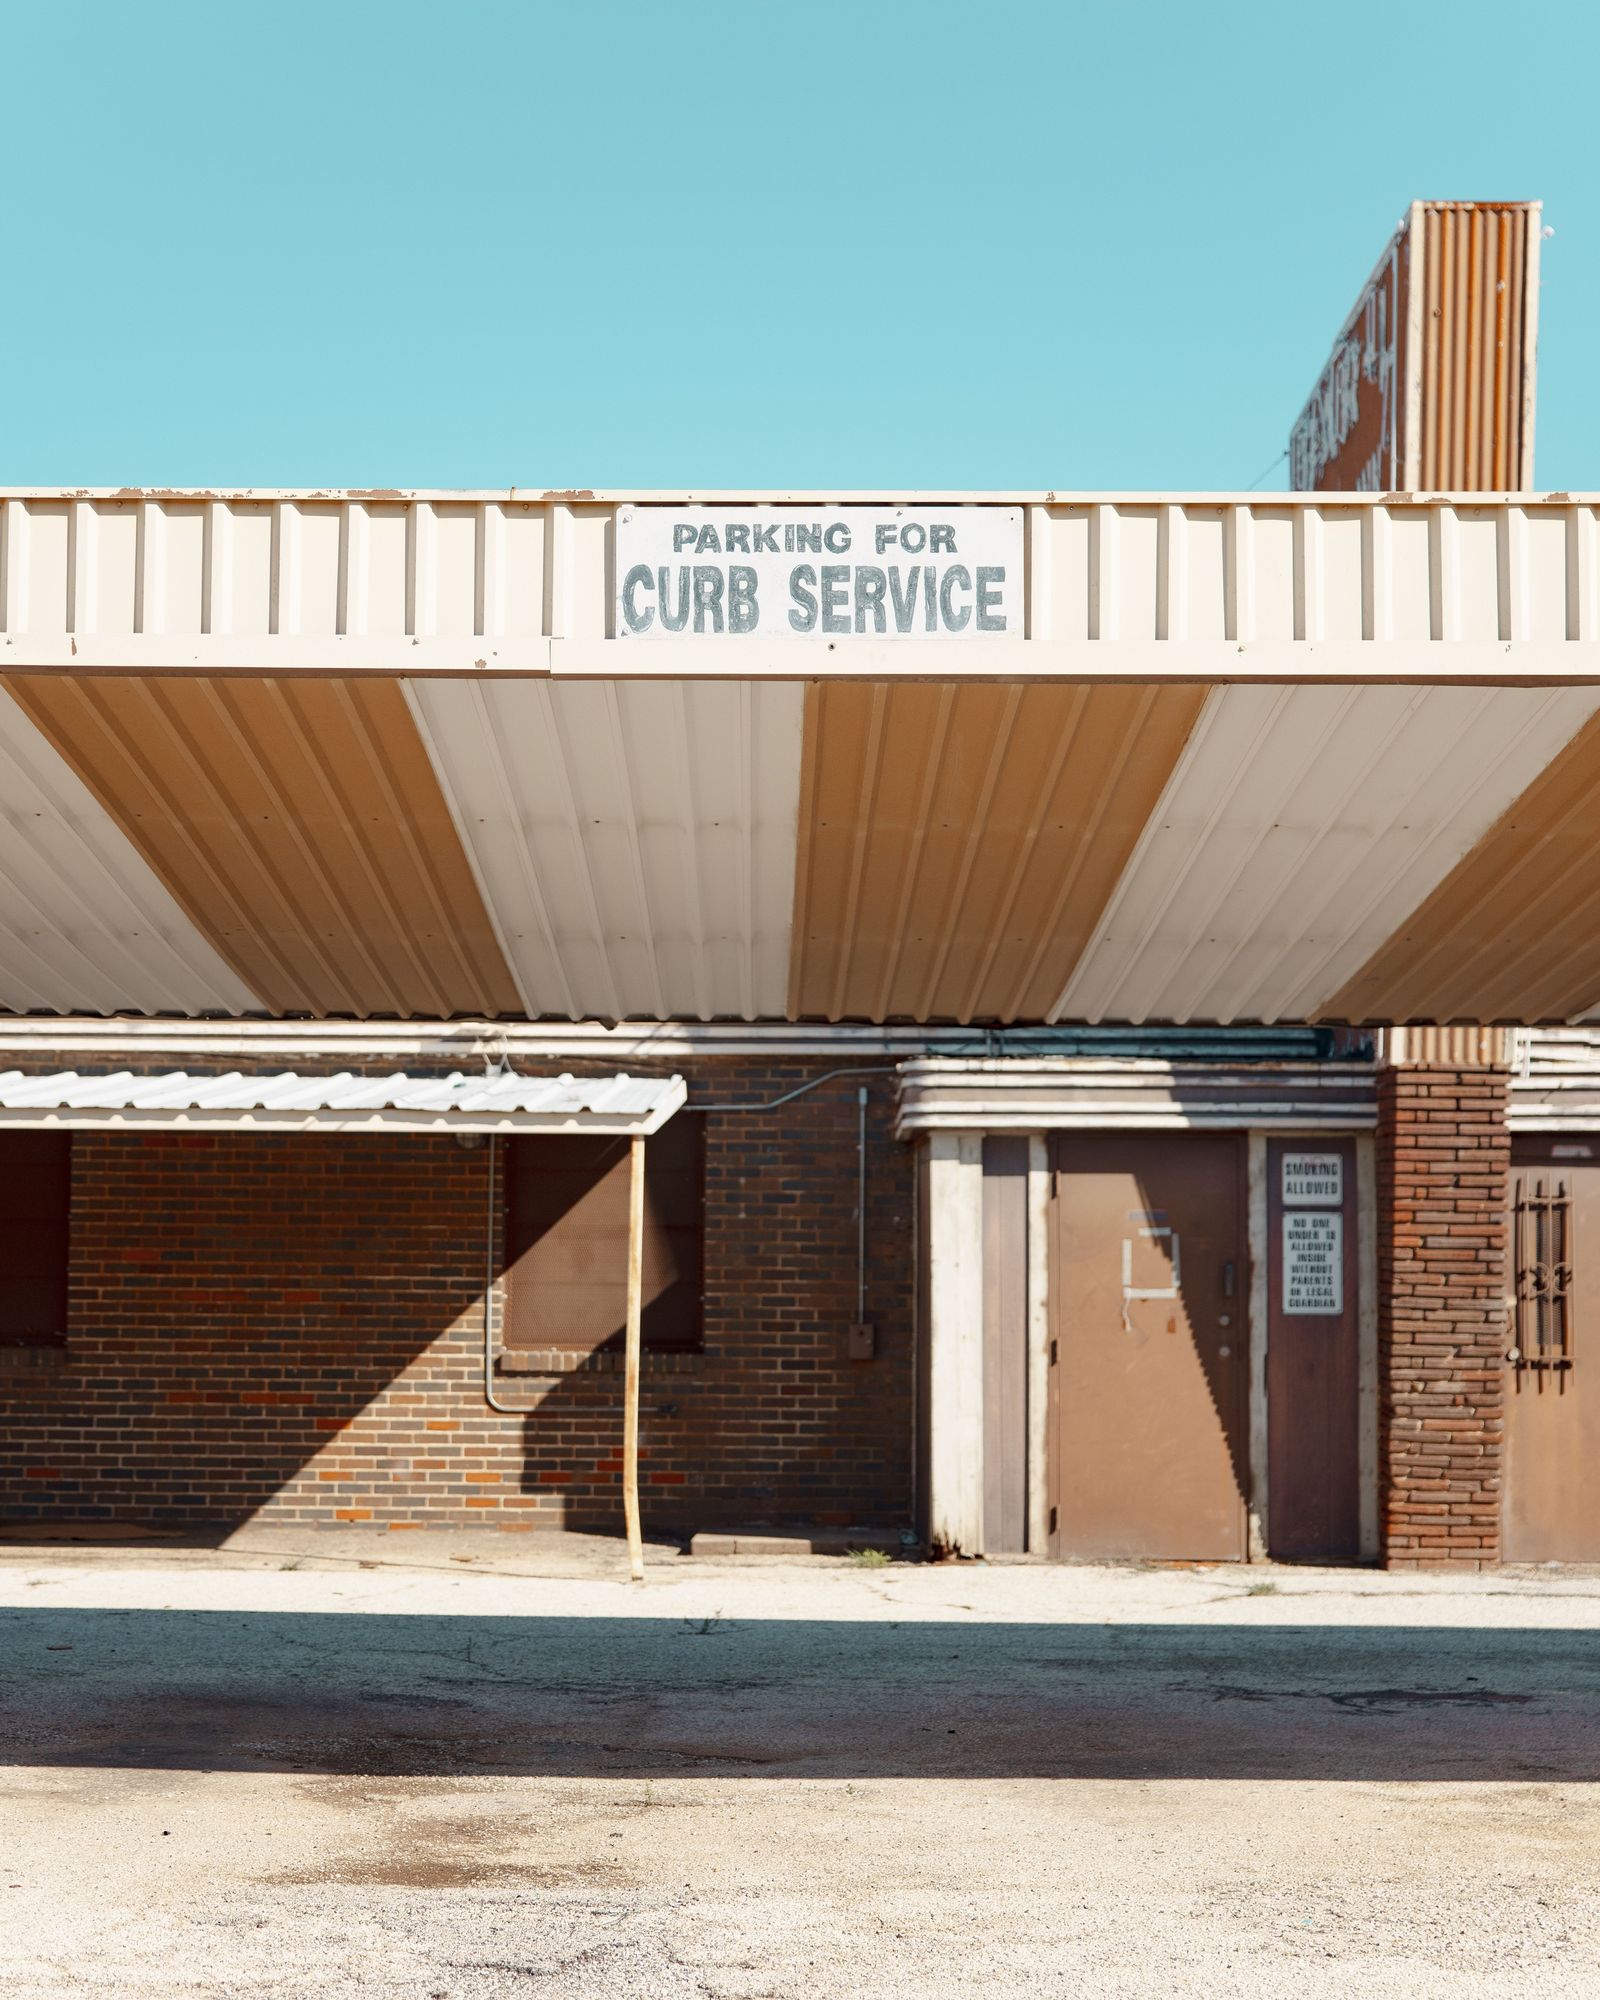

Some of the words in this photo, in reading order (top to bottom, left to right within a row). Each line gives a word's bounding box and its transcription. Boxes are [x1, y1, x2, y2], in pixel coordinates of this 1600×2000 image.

[673, 523, 852, 554] PARKING
[875, 522, 958, 554] FOR
[622, 563, 760, 634] CURB
[788, 563, 1007, 634] SERVICE
[1286, 1162, 1338, 1176] SMOKING
[1286, 1181, 1338, 1195] ALLOWED
[1293, 1218, 1307, 1228] NO
[1312, 1218, 1330, 1228] ONE
[1288, 1230, 1320, 1240] UNDER
[1291, 1242, 1334, 1251] ALLOWED
[1297, 1253, 1326, 1262] INSIDE
[1291, 1264, 1333, 1274] WITHOUT
[1291, 1276, 1333, 1285] PARENTS
[1290, 1287, 1301, 1296] OR
[1306, 1287, 1333, 1296] LEGAL
[1289, 1298, 1336, 1308] GUARDIAN
